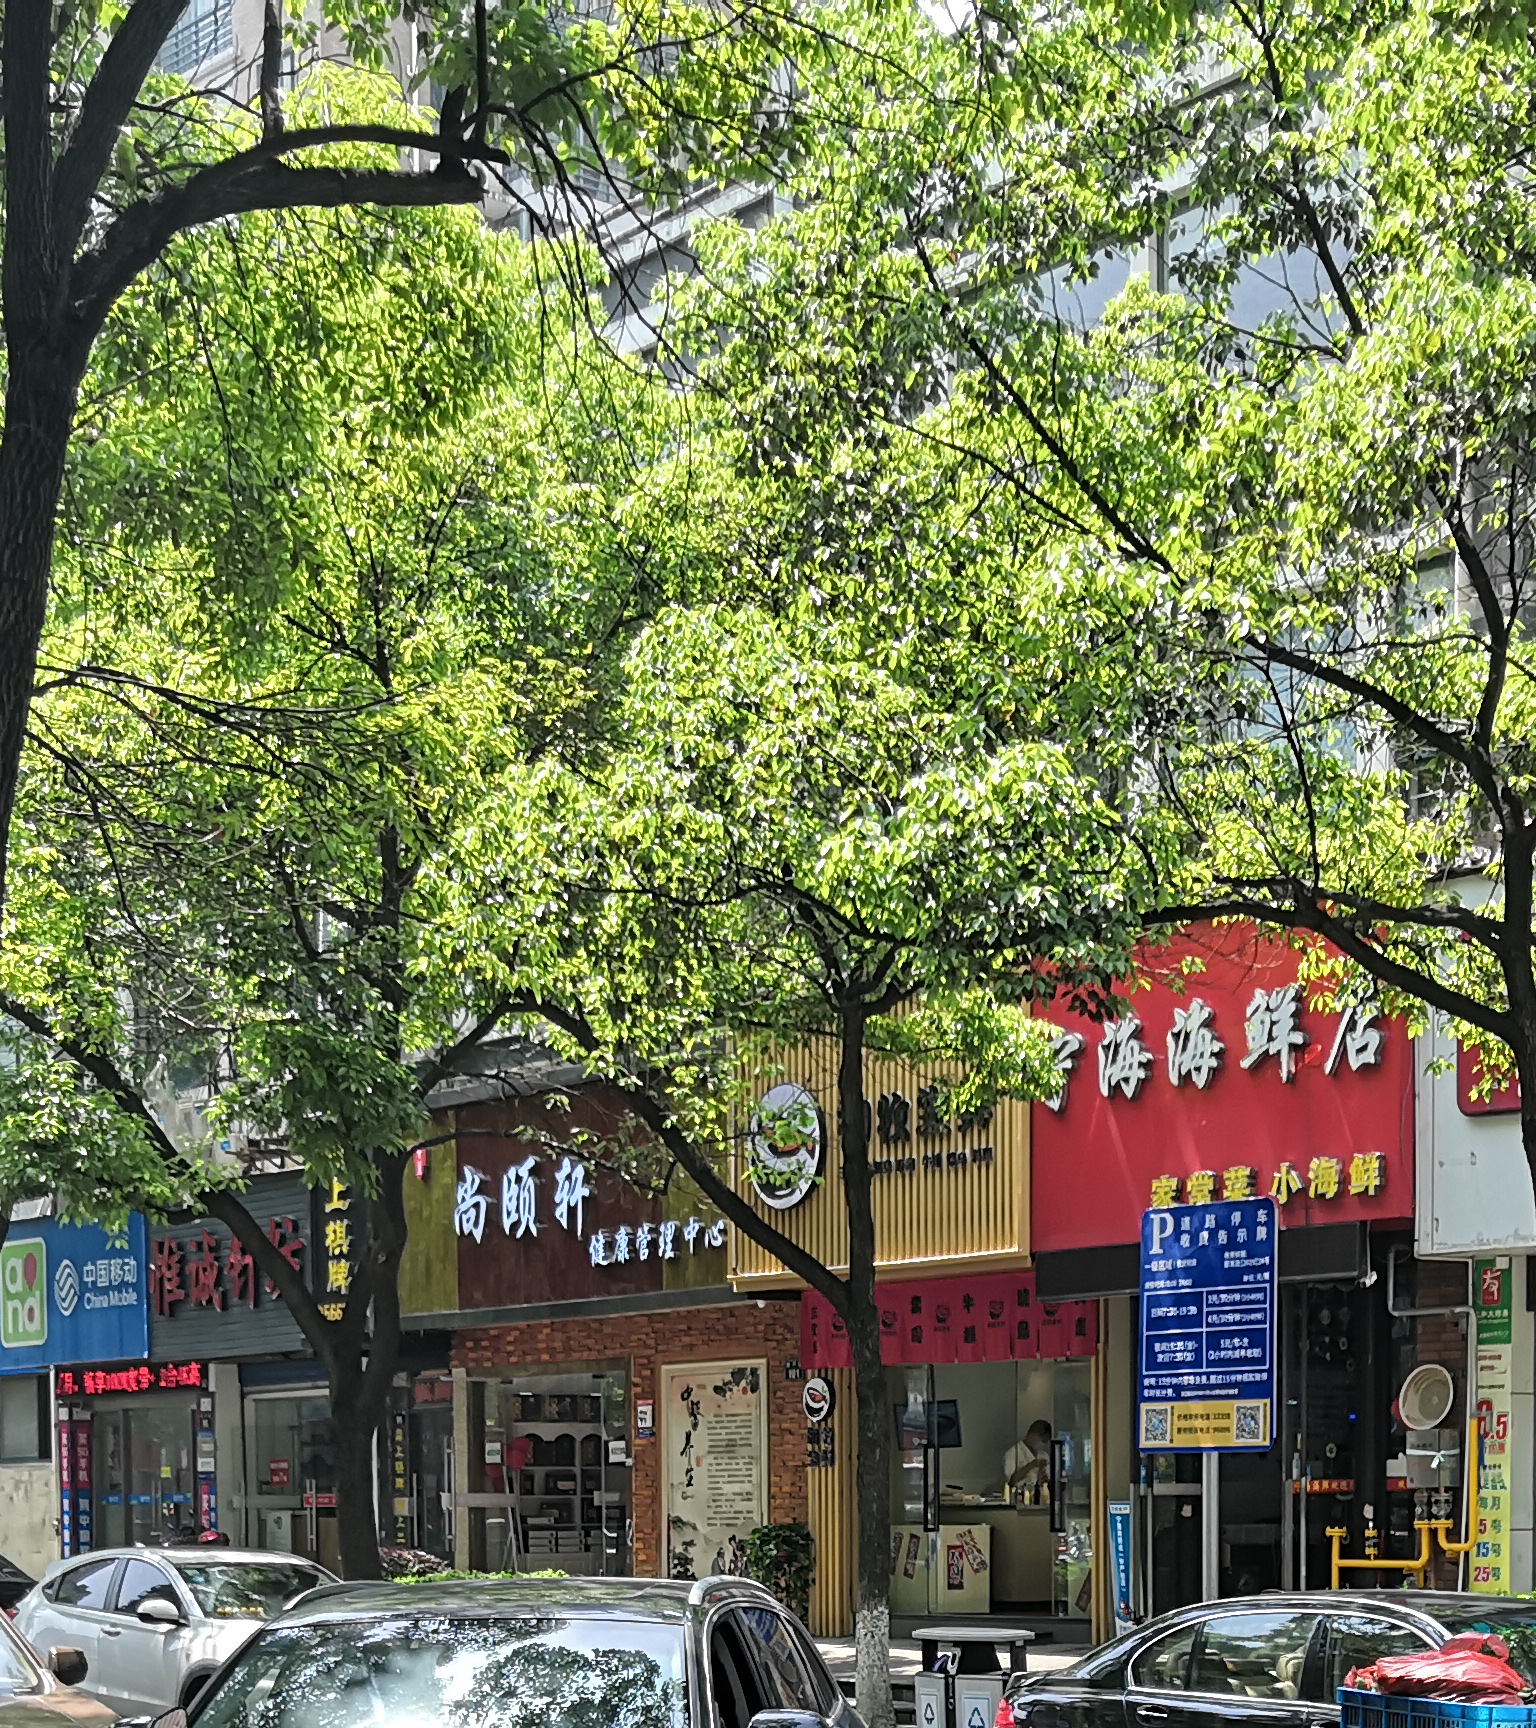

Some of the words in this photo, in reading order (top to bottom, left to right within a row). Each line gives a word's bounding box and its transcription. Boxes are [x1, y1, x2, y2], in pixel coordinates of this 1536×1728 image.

[1269, 1151, 1384, 1204] 小海鲜
[1149, 1212, 1175, 1255] P
[1180, 1208, 1269, 1231] 道路停车
[588, 1216, 727, 1268] 健康管理中心
[1179, 1225, 1268, 1248] 收费告示牌
[83, 1256, 138, 1289] 中国移动
[84, 1291, 109, 1310] China
[109, 1286, 138, 1307] Mobile
